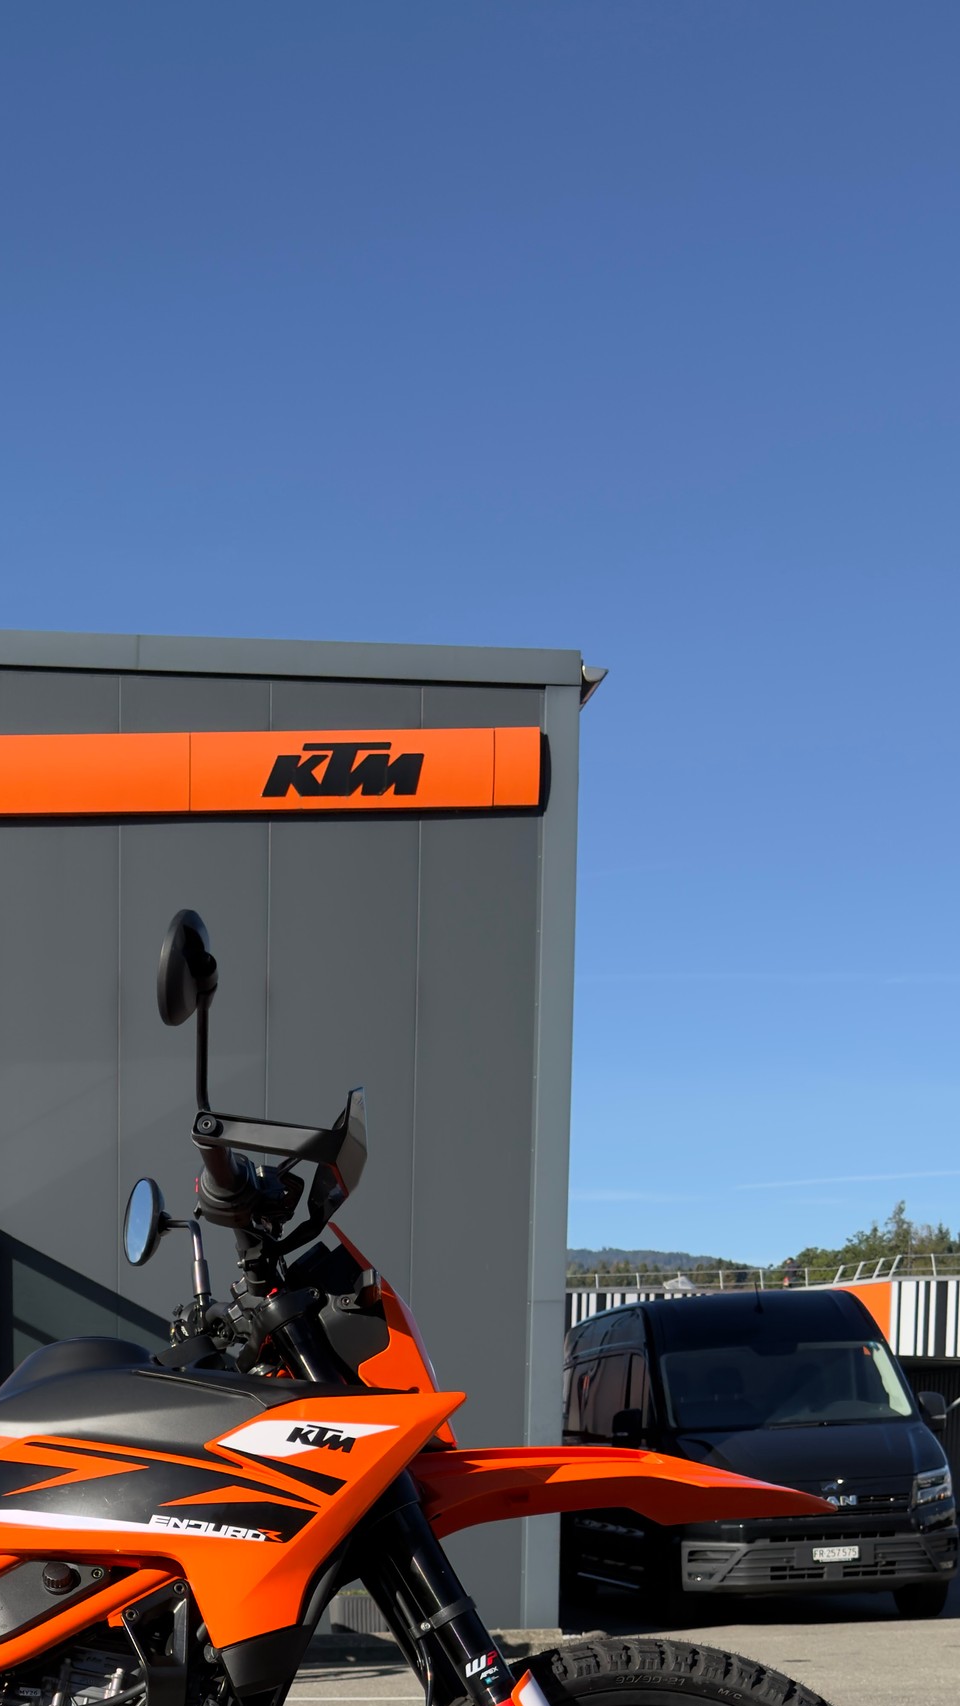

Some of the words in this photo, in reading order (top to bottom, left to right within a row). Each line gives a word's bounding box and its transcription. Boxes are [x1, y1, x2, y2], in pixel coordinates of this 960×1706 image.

[261, 742, 424, 797] KTM
[286, 1424, 356, 1453] KTM
[825, 1495, 857, 1506] AN
[148, 1514, 266, 1542] ENDURO
[465, 1650, 498, 1678] WP
